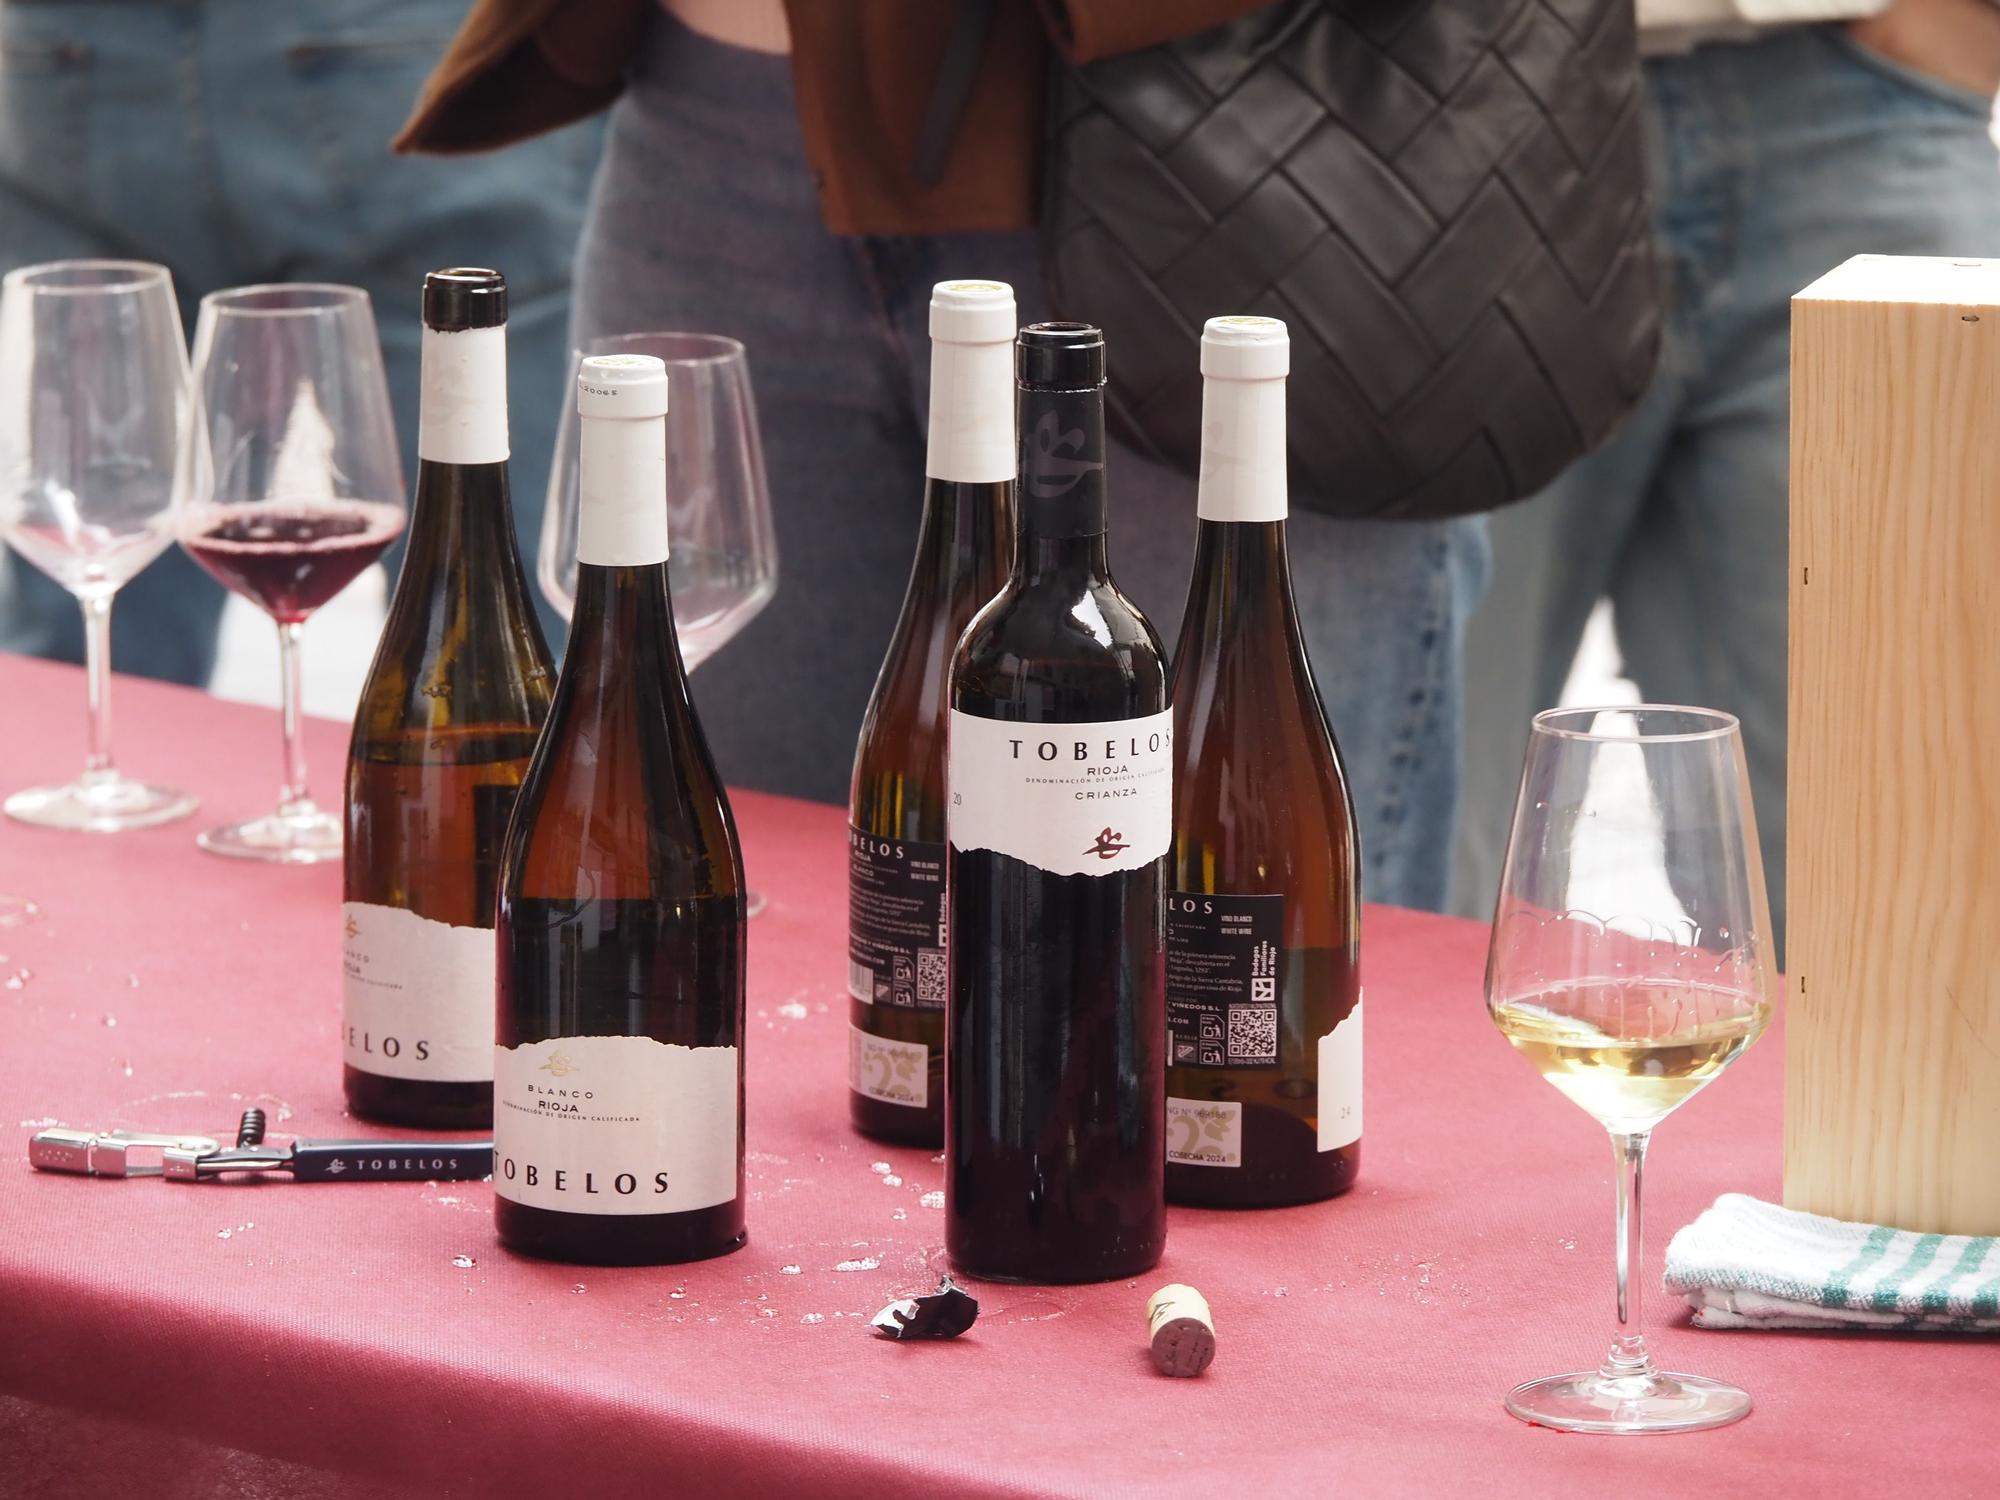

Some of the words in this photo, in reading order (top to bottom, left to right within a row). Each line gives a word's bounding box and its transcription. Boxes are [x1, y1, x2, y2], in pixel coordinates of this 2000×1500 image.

[1009, 728, 1170, 761] TOBELOS
[1087, 765, 1128, 776] RIOJA
[953, 792, 962, 805] 20
[1075, 788, 1138, 800] CRIANZA
[1269, 947, 1277, 966] Rioja
[1269, 967, 1275, 976] de
[527, 1084, 594, 1099] BLANCO
[538, 1100, 579, 1113] RIOJA
[1169, 1150, 1204, 1161] COSECHA
[1207, 1153, 1226, 1163] 2024
[357, 1158, 457, 1171] TOBELOS
